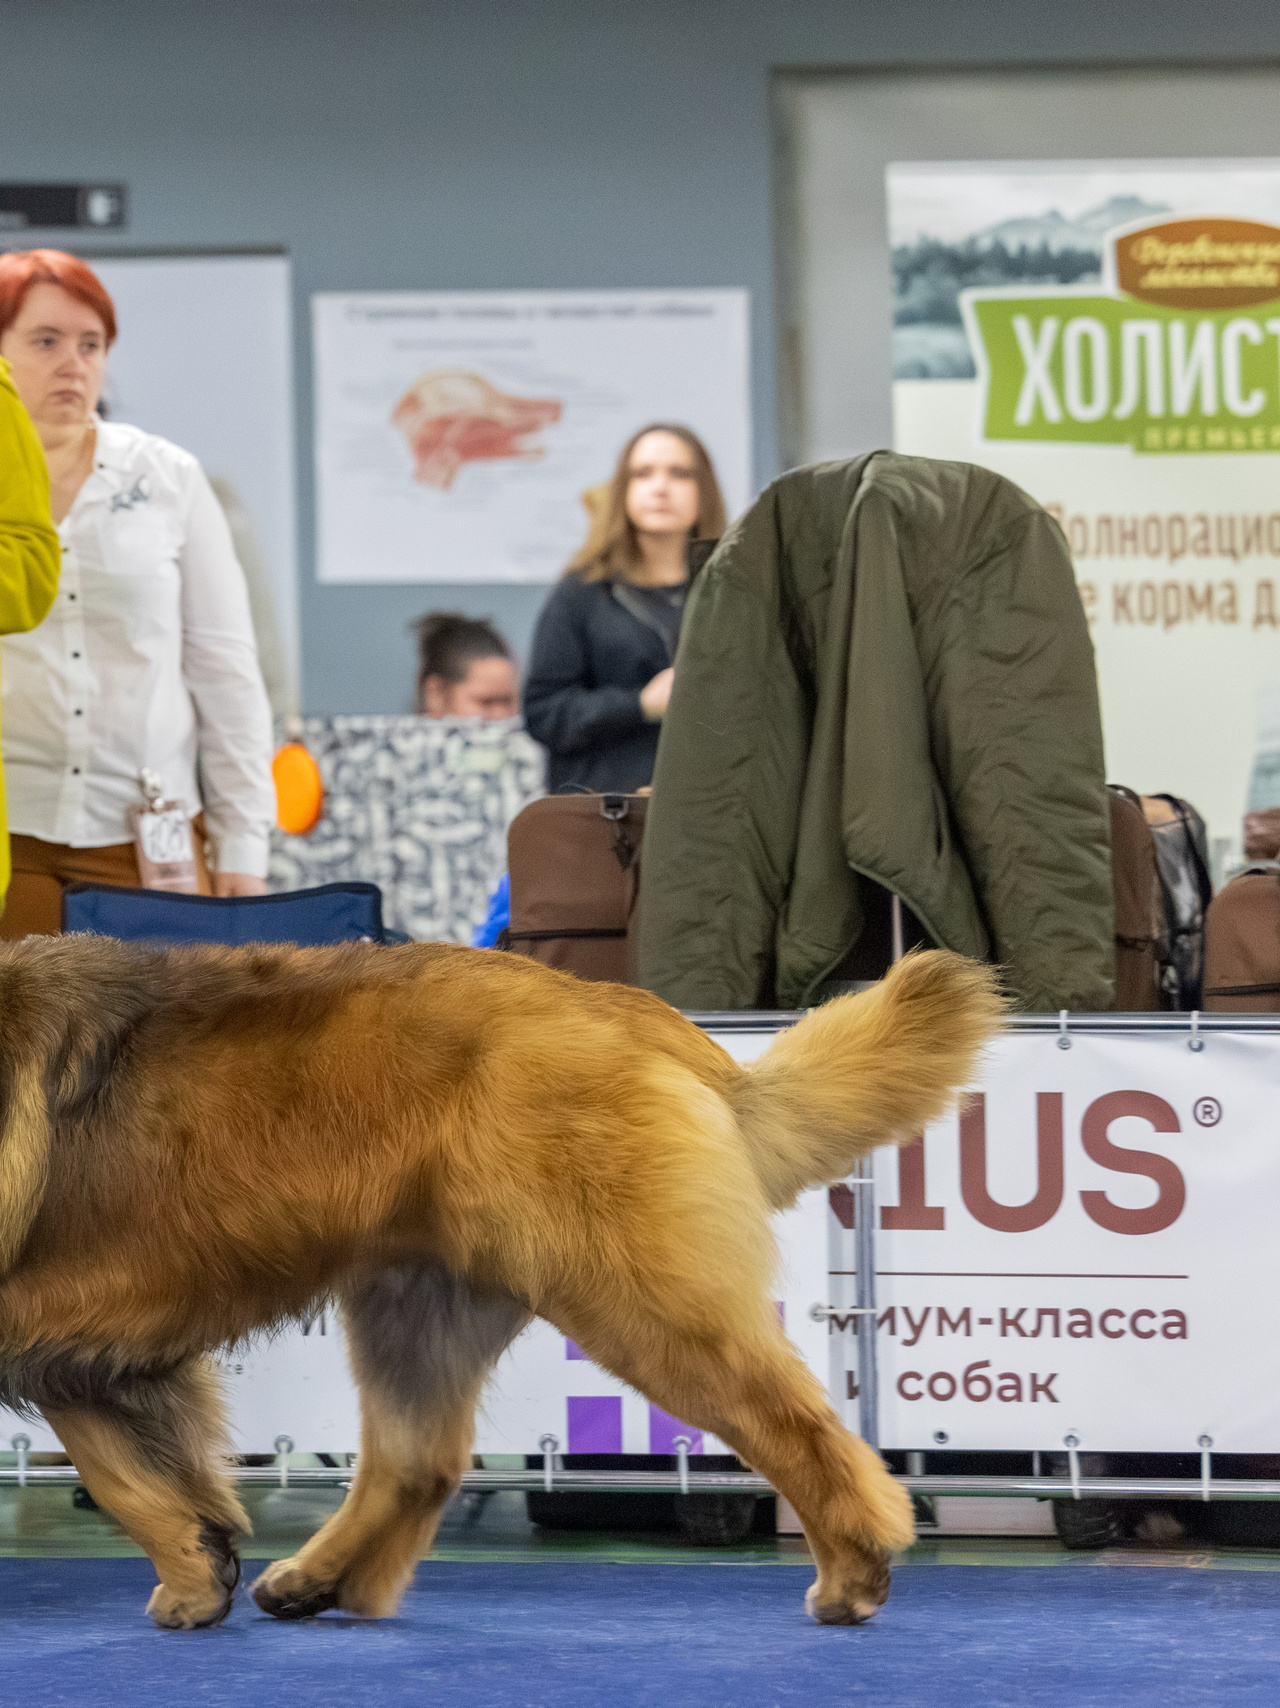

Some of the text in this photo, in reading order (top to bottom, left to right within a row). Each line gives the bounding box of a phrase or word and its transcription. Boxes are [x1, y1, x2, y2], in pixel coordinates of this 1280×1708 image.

[1046, 503, 1280, 564] олнорацио
[1113, 580, 1238, 632] корма
[896, 1360, 1061, 1404] собак
